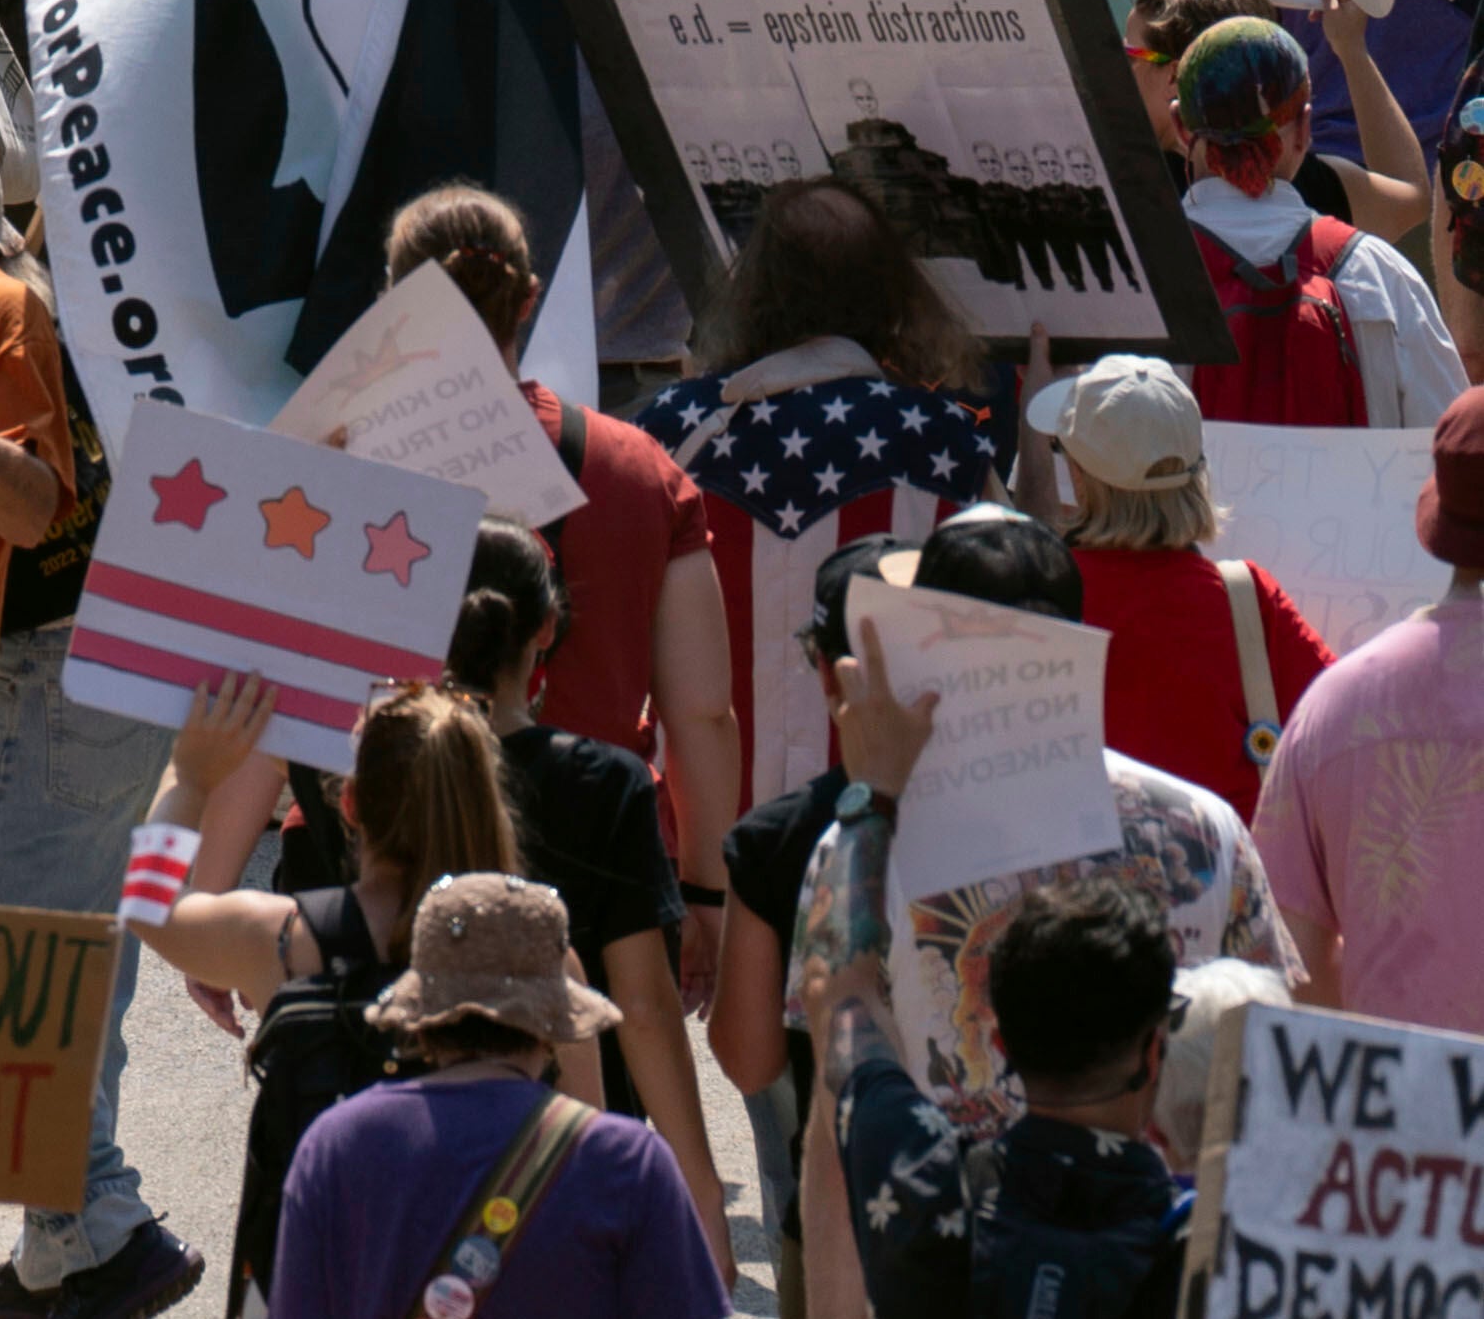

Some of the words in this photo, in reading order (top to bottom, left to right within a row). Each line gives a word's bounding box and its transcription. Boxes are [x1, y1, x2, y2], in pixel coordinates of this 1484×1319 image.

[669, 4, 723, 47] e.d.
[764, 3, 861, 53] epstein
[867, 0, 1025, 44] distractions
[1271, 1023, 1402, 1130] WE
